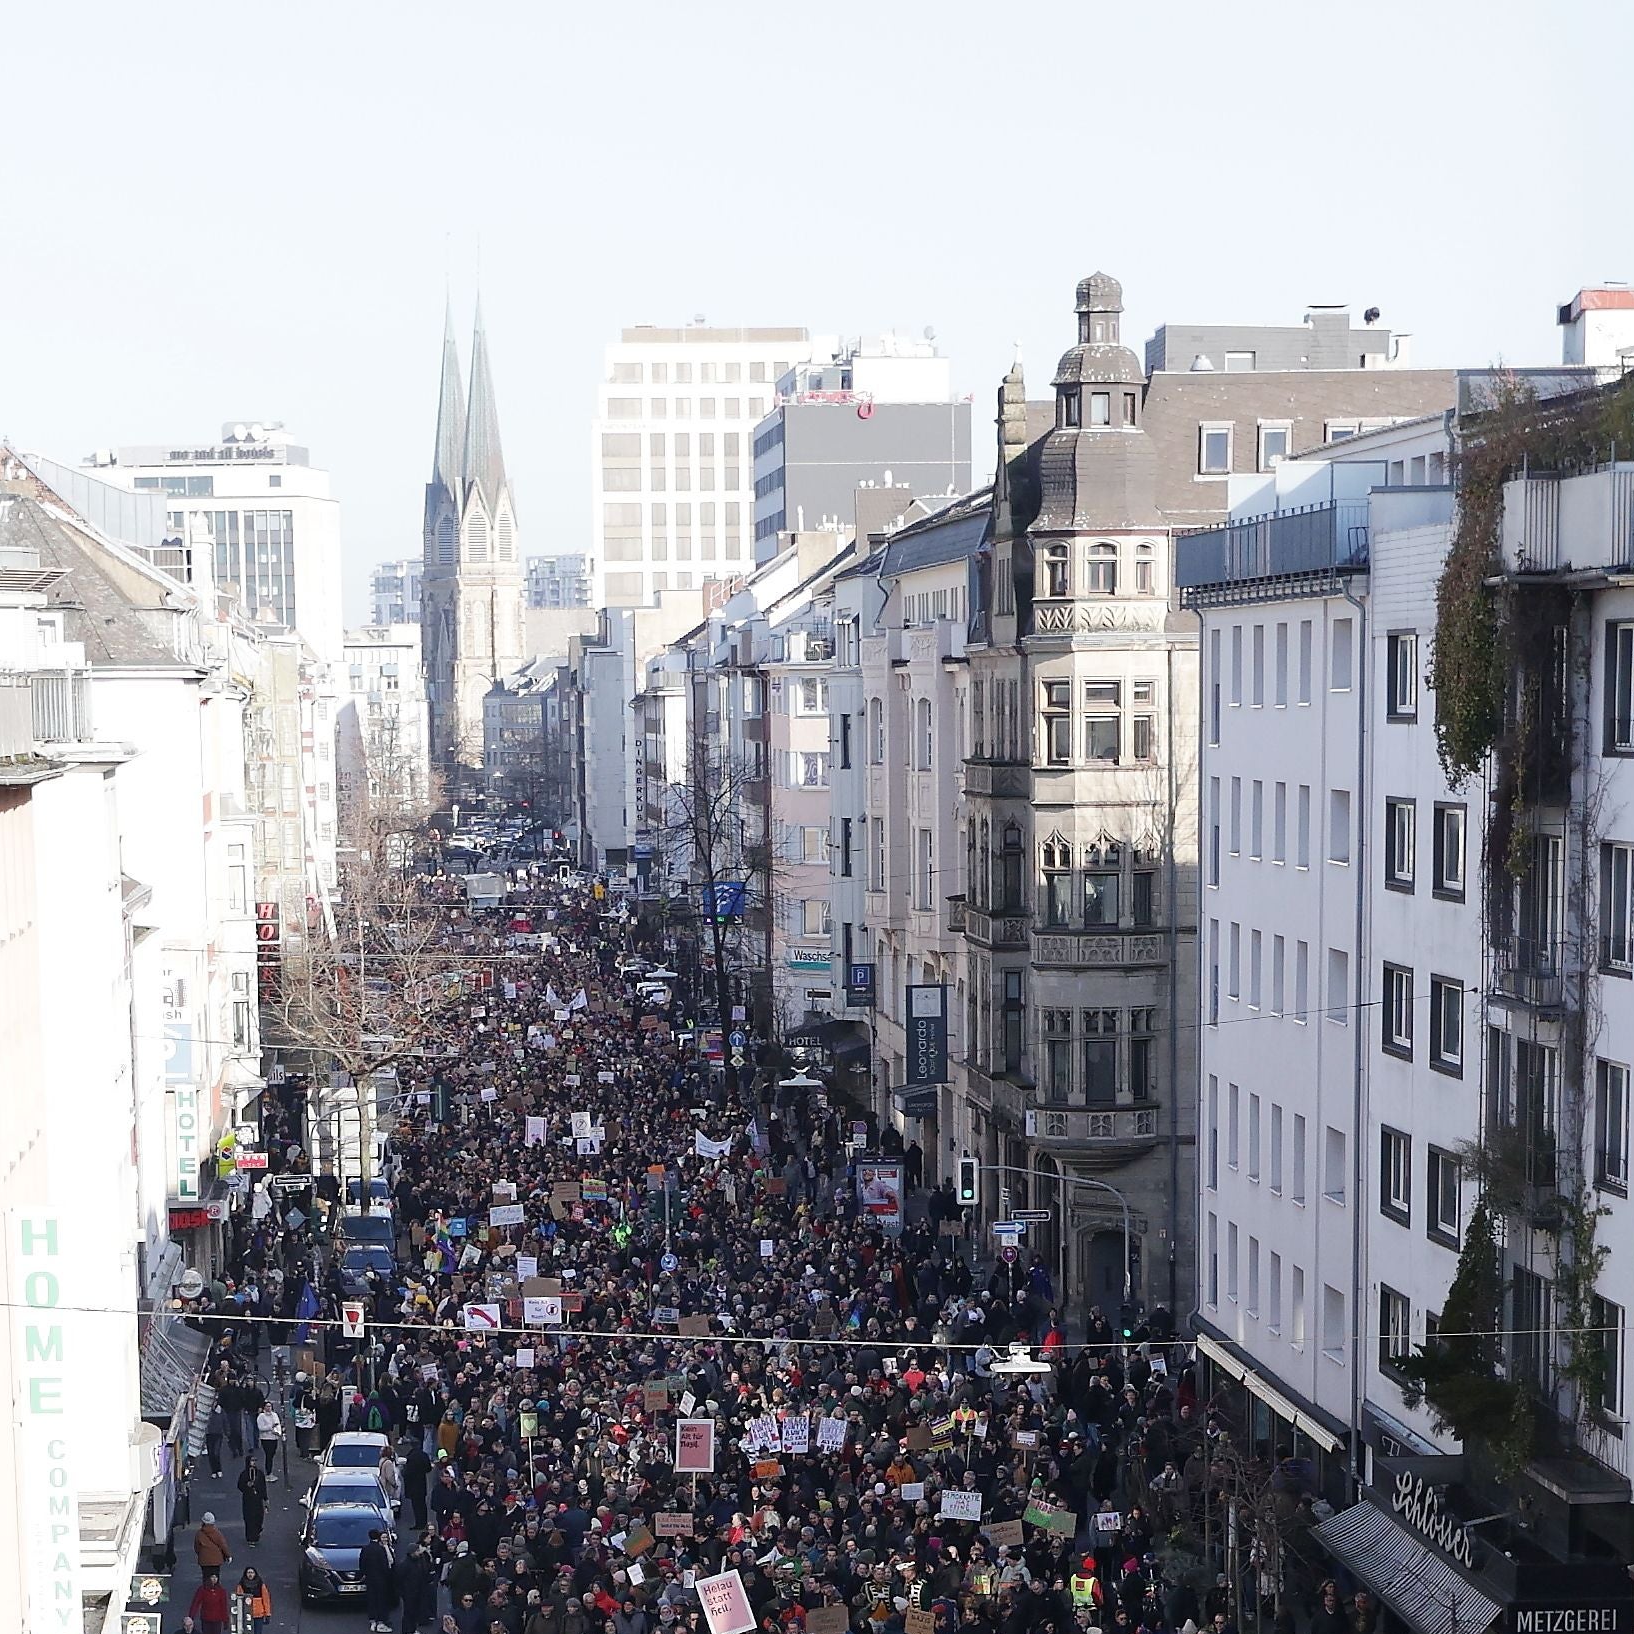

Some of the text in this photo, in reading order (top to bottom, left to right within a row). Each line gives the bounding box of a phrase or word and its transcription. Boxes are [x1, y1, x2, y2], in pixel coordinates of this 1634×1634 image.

[788, 1036, 822, 1047] HOTEL
[917, 1020, 927, 1079] Leonardo
[177, 1091, 197, 1197] HOTEL
[20, 1219, 64, 1434] HOME
[45, 1438, 74, 1629] COMPANY
[1516, 1608, 1617, 1633] METZGEREI
